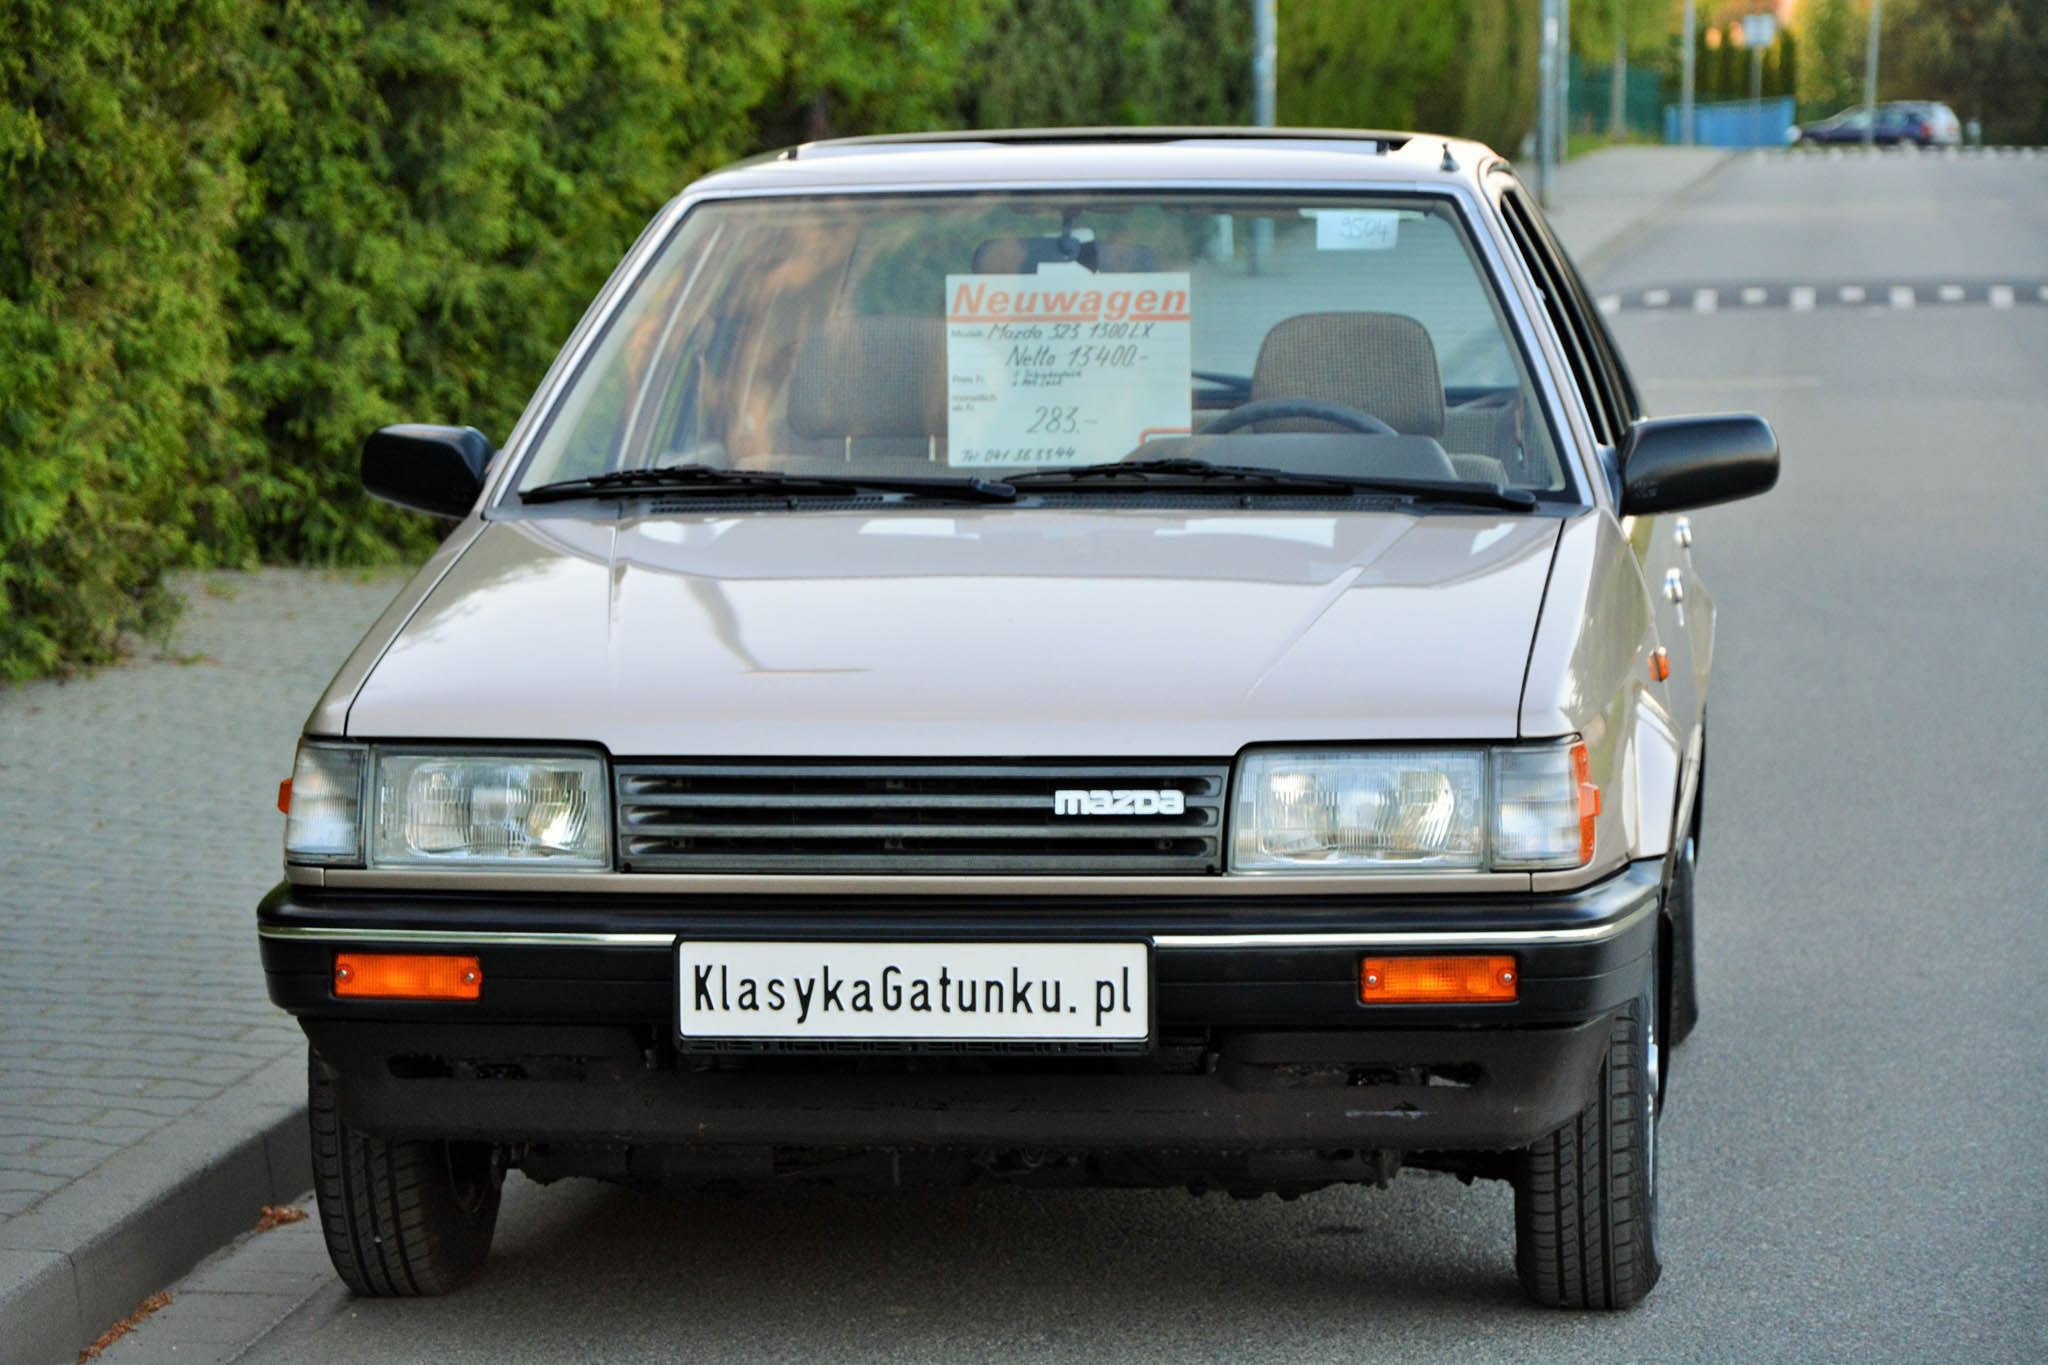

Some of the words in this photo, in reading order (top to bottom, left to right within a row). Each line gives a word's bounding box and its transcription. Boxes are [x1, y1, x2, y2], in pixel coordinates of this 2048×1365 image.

[952, 283, 1187, 321] Neuwagen
[1004, 345, 1056, 367] Netto
[1054, 789, 1186, 816] mazda
[693, 964, 1133, 1027] KlasykaGatunku.pl
